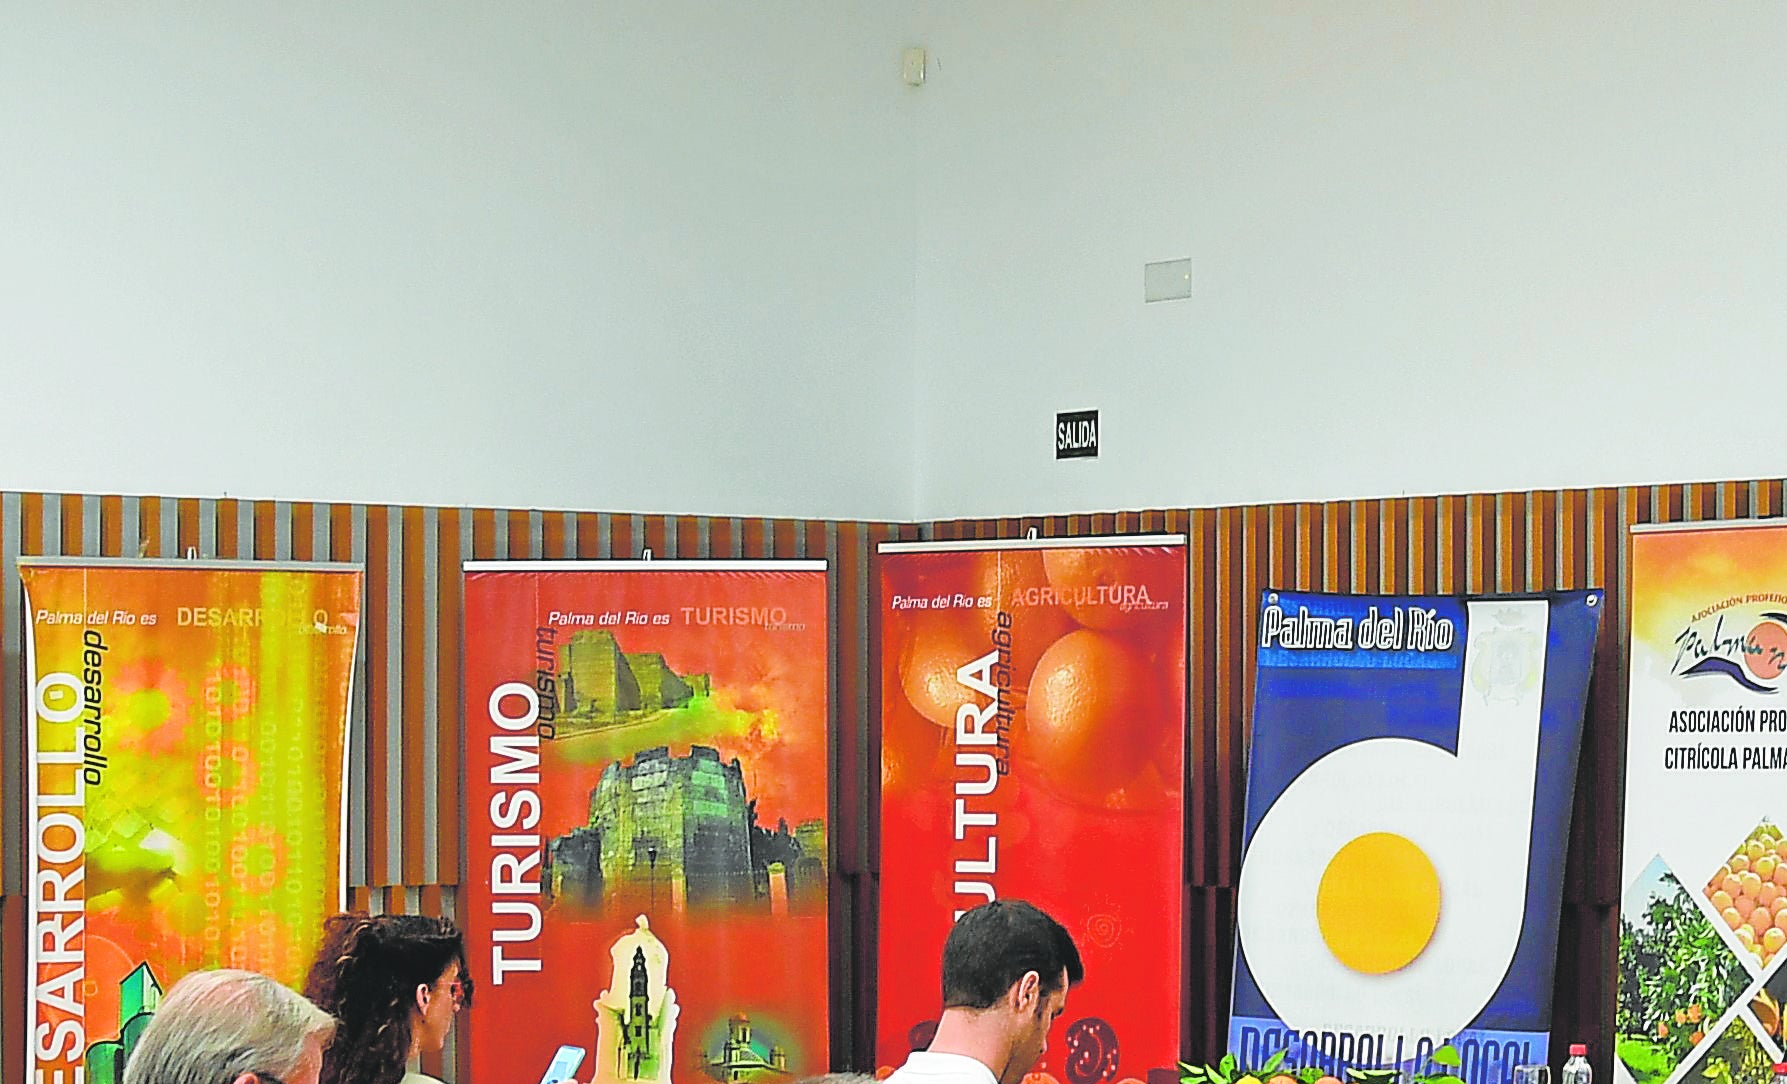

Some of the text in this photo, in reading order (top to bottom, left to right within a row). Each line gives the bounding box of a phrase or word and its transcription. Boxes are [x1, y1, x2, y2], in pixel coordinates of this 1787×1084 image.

[1058, 420, 1097, 450] SALIDA
[892, 594, 928, 610] Palma
[931, 595, 950, 609] del
[977, 596, 993, 609] es
[1010, 583, 1150, 607] AGRICULTURA
[35, 609, 83, 626] Palma
[87, 609, 109, 626] del
[140, 613, 158, 626] es
[548, 611, 594, 626] Palma
[598, 611, 621, 626] del
[652, 614, 671, 626] es
[680, 607, 788, 627] TURISMO
[1261, 605, 1353, 650] Palma
[1357, 605, 1404, 650] del
[1407, 606, 1454, 652] Río
[536, 625, 559, 741] turismo
[992, 611, 1014, 777] agricultura
[83, 629, 109, 786] desarrollo
[1668, 705, 1754, 733] ASOCIACIÓN
[1664, 743, 1738, 770] CITRÍCOLA
[953, 648, 1001, 923] ULTURA
[488, 681, 543, 986] TURISMO
